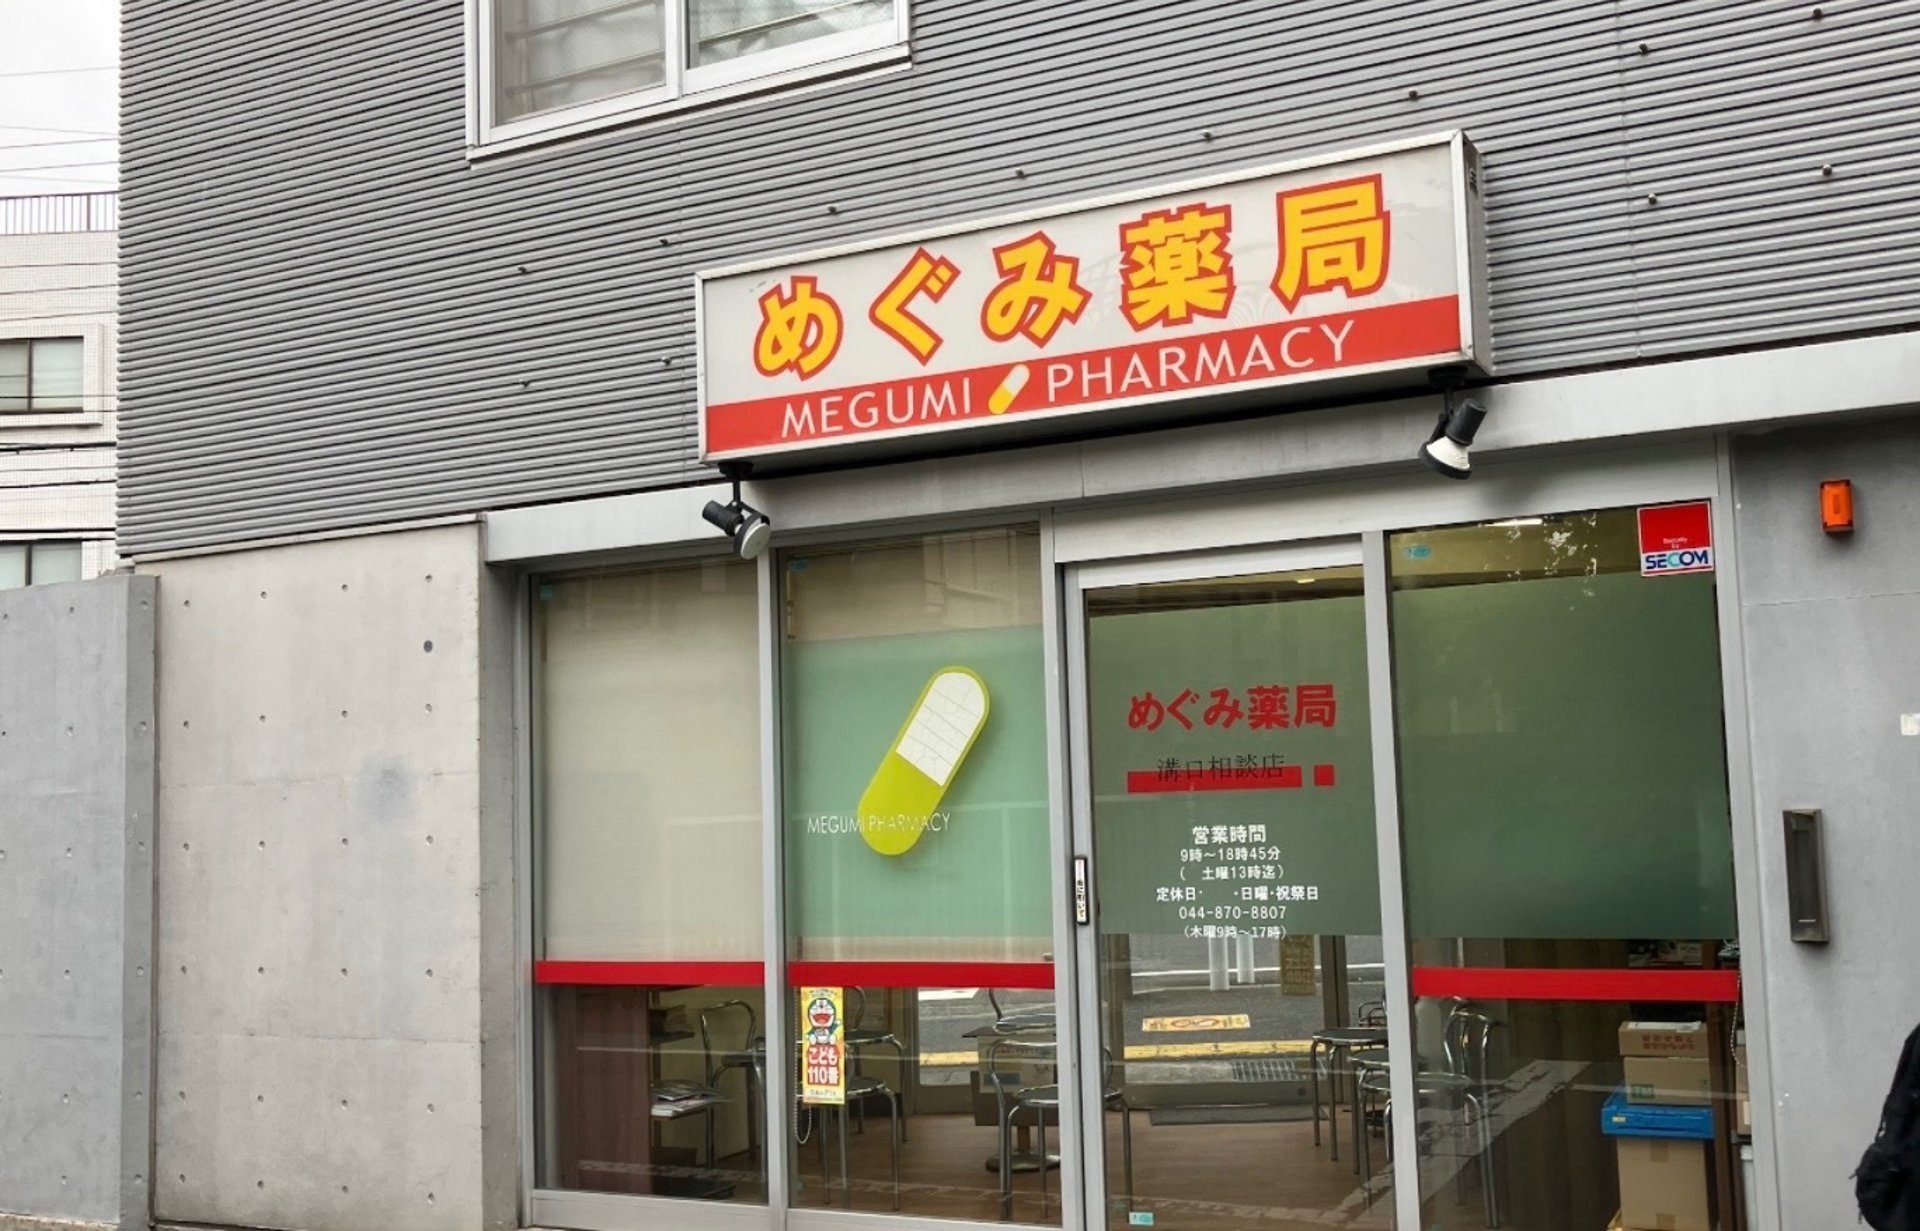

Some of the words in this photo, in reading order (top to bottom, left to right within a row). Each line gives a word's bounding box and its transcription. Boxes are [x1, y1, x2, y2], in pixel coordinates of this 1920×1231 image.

[753, 173, 1392, 381] めぐみ薬局
[780, 377, 972, 439] MEGUMI
[1046, 319, 1357, 403] PHARMACY
[1645, 550, 1709, 570] SECOM
[1127, 684, 1337, 731] めぐみ薬局
[1157, 753, 1285, 783] 溝口相談店
[807, 815, 865, 834] MEGUMI
[869, 812, 951, 833] PHARMACY
[1192, 824, 1267, 845] 営業時間
[1178, 905, 1287, 920] 044-870-8807
[808, 1046, 838, 1065] こども
[807, 1066, 839, 1085] 110番
